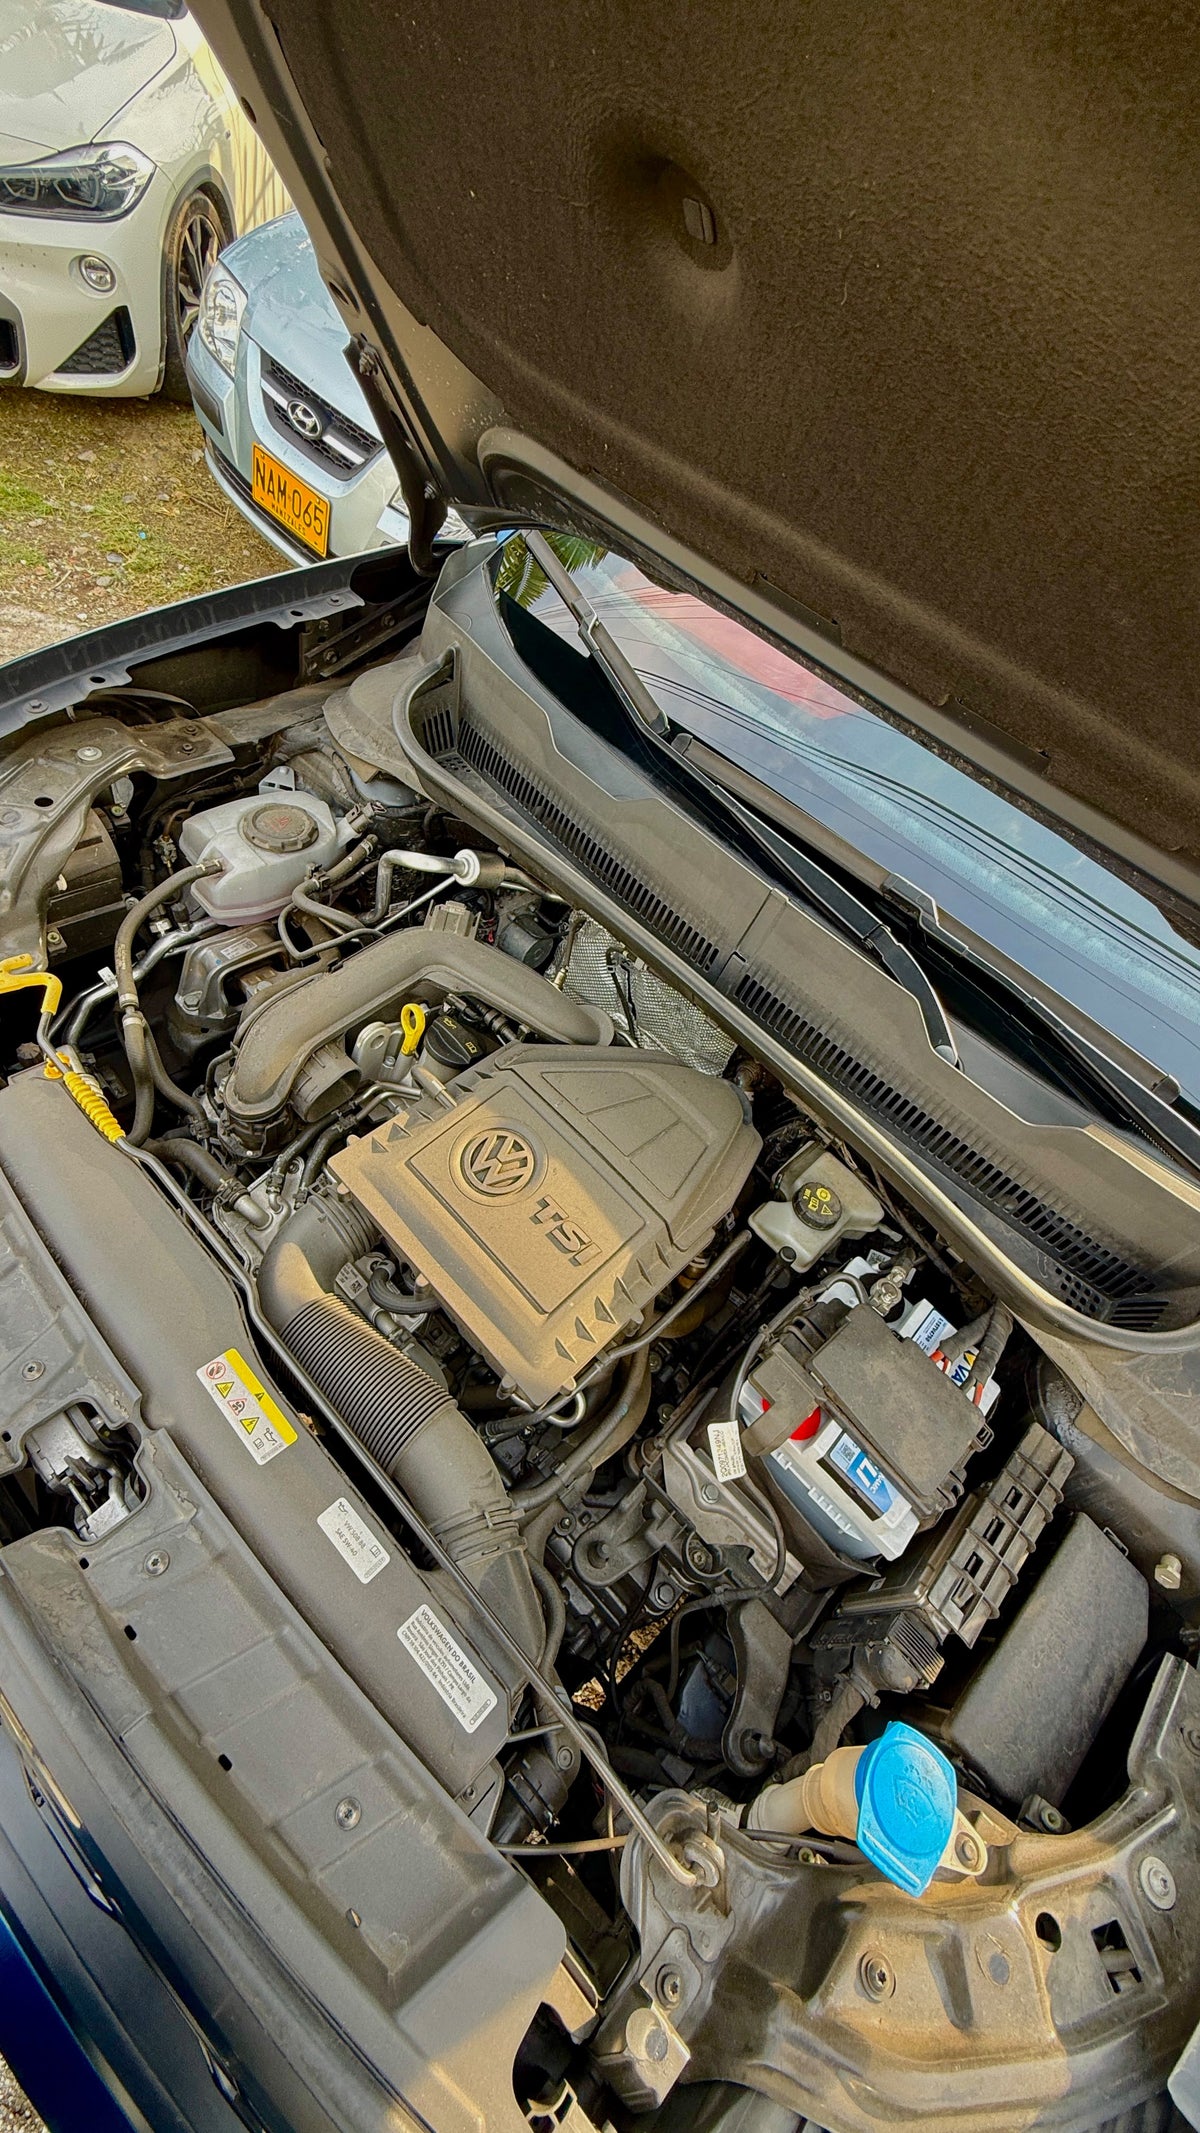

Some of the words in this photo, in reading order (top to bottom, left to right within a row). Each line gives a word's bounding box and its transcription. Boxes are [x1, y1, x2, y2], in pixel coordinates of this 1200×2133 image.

[529, 1194, 603, 1267] TSI
[951, 1364, 971, 1383] VA
[334, 1527, 345, 1539] SAE
[343, 1520, 353, 1531] VW
[419, 1609, 453, 1652] VOLKSWAGEN
[450, 1650, 461, 1662] DO
[458, 1660, 477, 1684] BRASIL
